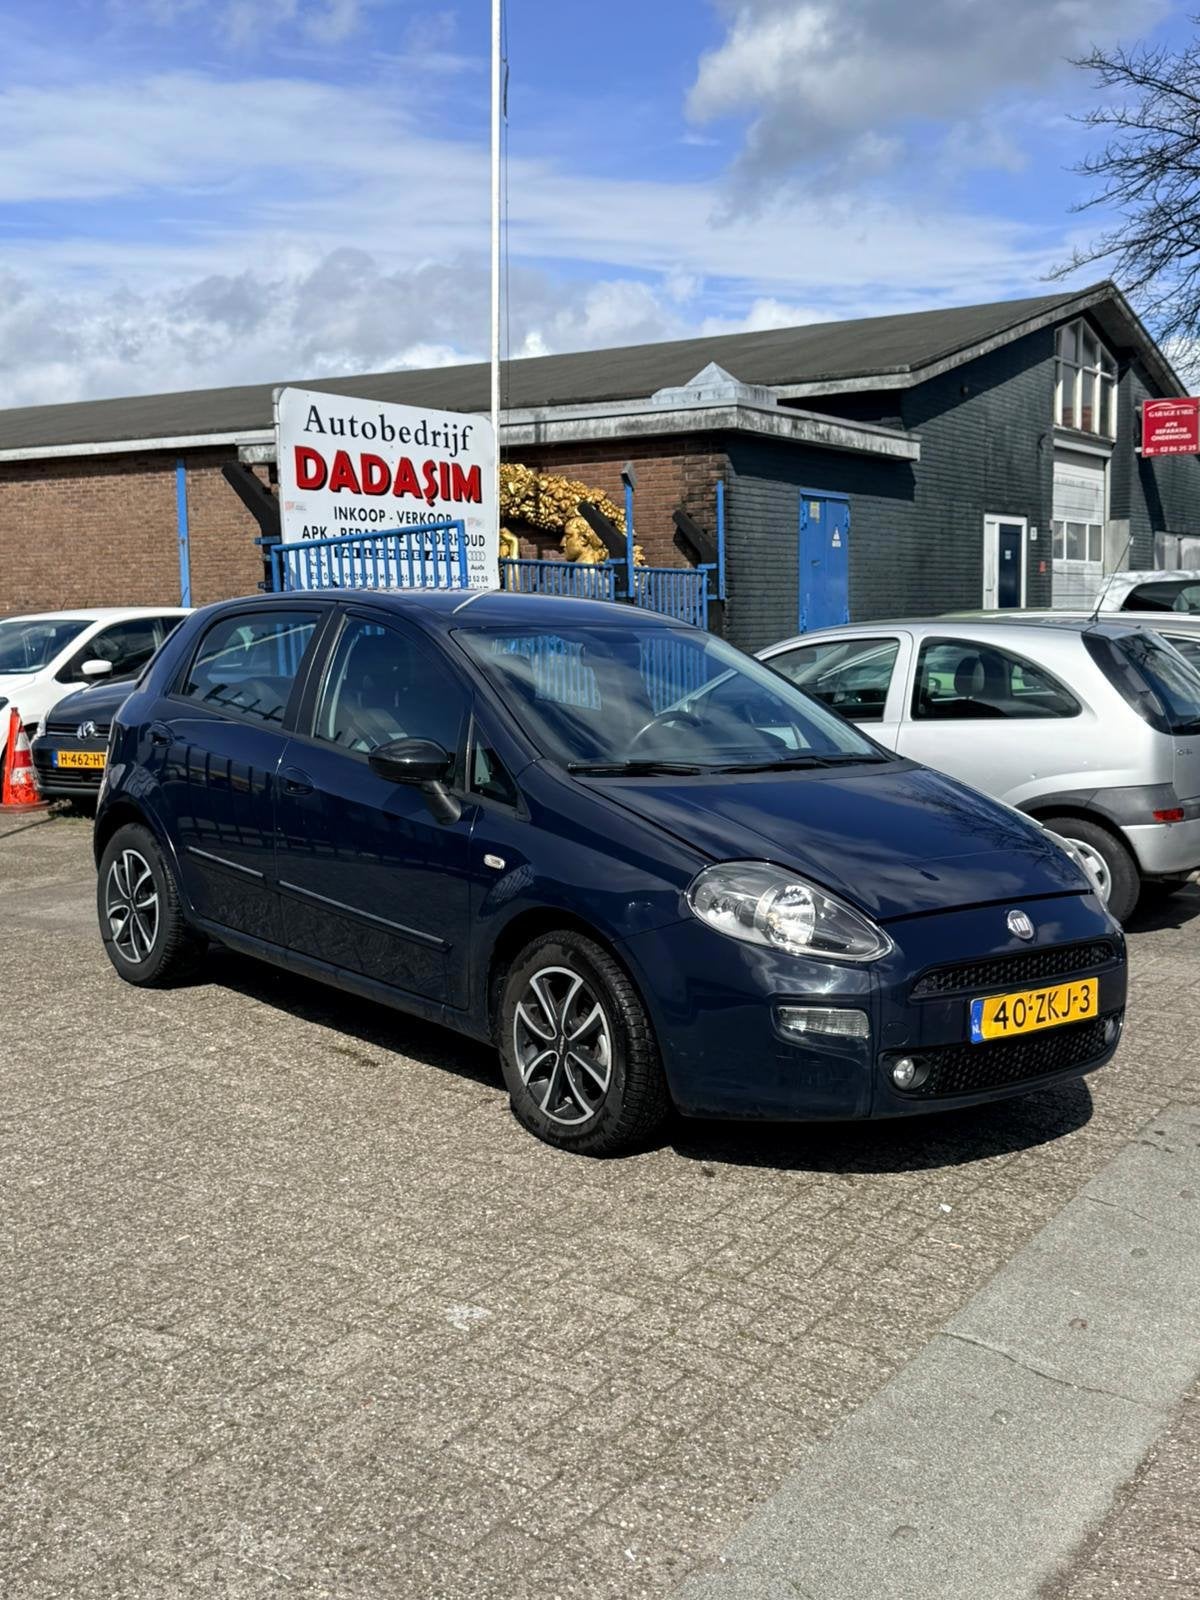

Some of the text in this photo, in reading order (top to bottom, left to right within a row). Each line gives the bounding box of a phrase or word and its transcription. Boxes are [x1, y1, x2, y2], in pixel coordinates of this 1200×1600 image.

[303, 405, 473, 457] Autobedrijf
[294, 445, 482, 507] DADAŞIM
[334, 506, 386, 522] INKOOP
[396, 511, 453, 525] VERKOOP
[302, 525, 327, 539] APK
[61, 754, 106, 766] H-462-HT
[993, 985, 1091, 1030] 40-ZKJ-3
